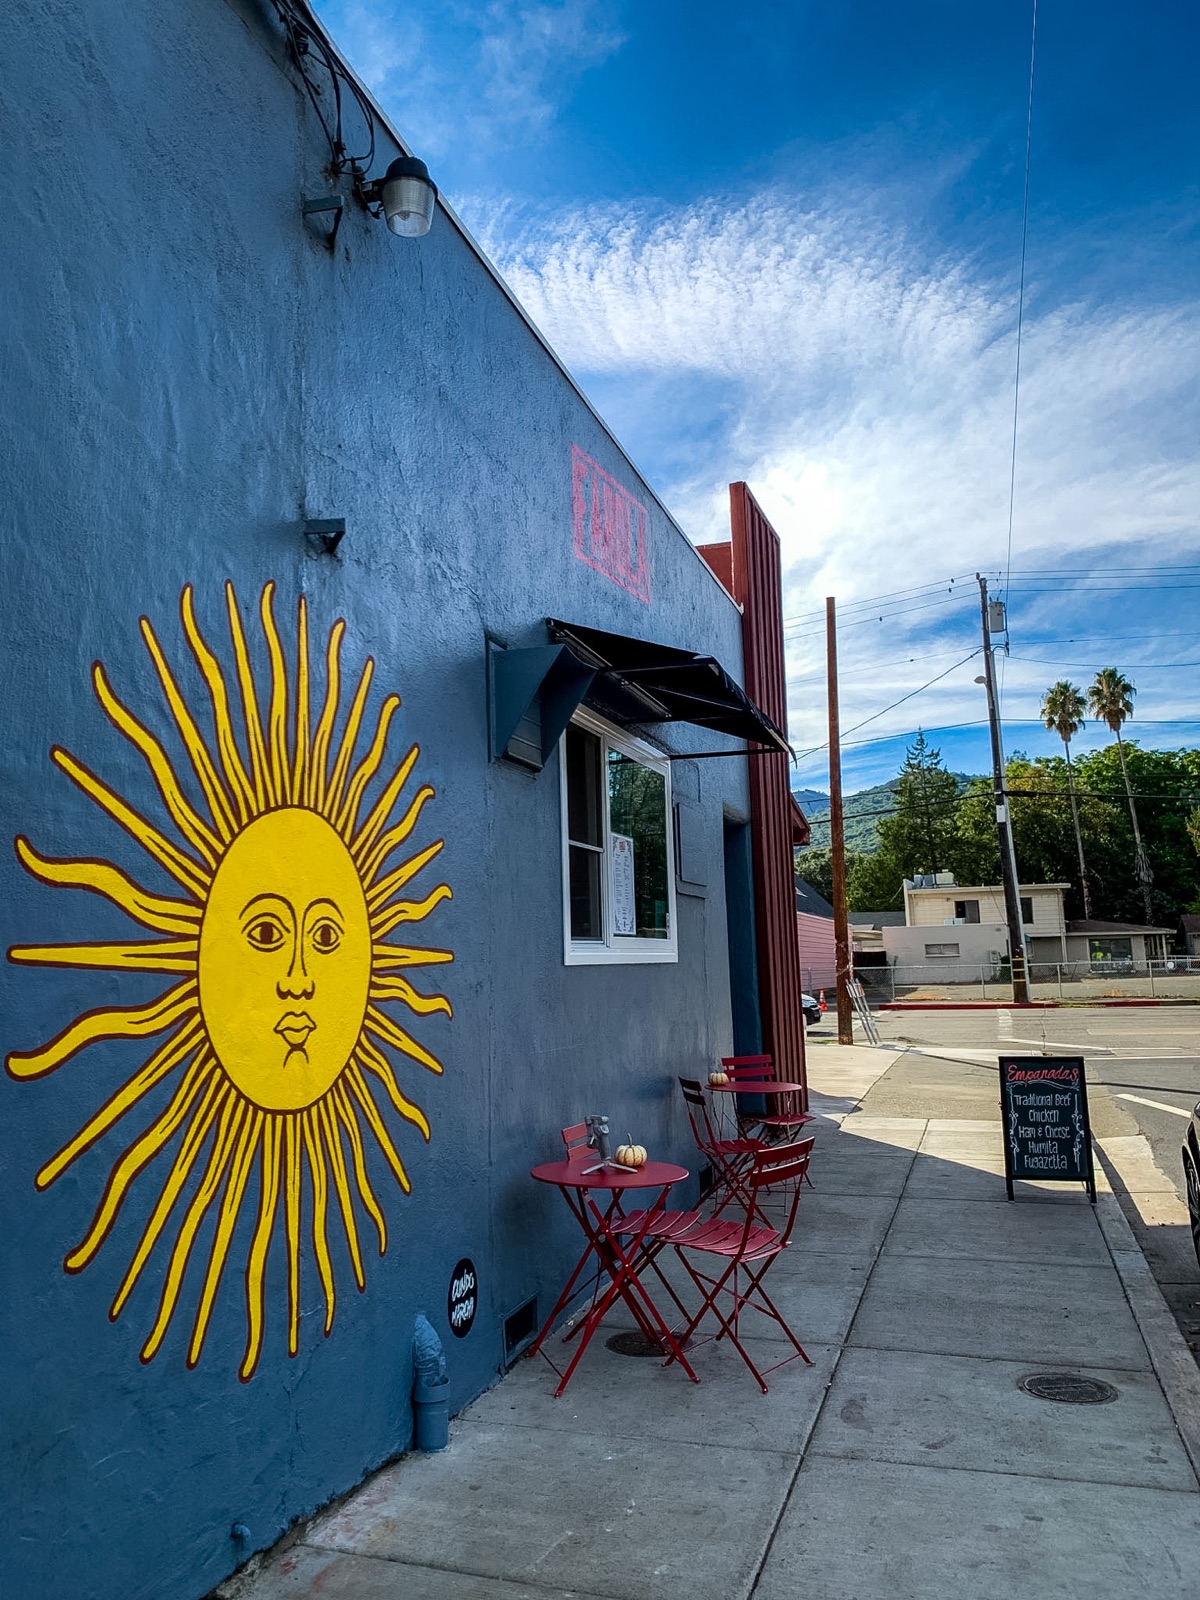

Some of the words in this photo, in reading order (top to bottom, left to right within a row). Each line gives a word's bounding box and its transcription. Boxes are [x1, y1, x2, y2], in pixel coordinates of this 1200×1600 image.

[1007, 1064, 1079, 1083] Empanadas
[1013, 1094, 1053, 1106] Traditional
[1054, 1093, 1072, 1106] Beef
[1028, 1109, 1059, 1122] Chicken
[1018, 1125, 1036, 1138] Ham
[1038, 1126, 1043, 1137] &
[1045, 1126, 1071, 1139] Cheese
[1028, 1141, 1059, 1154] Humita
